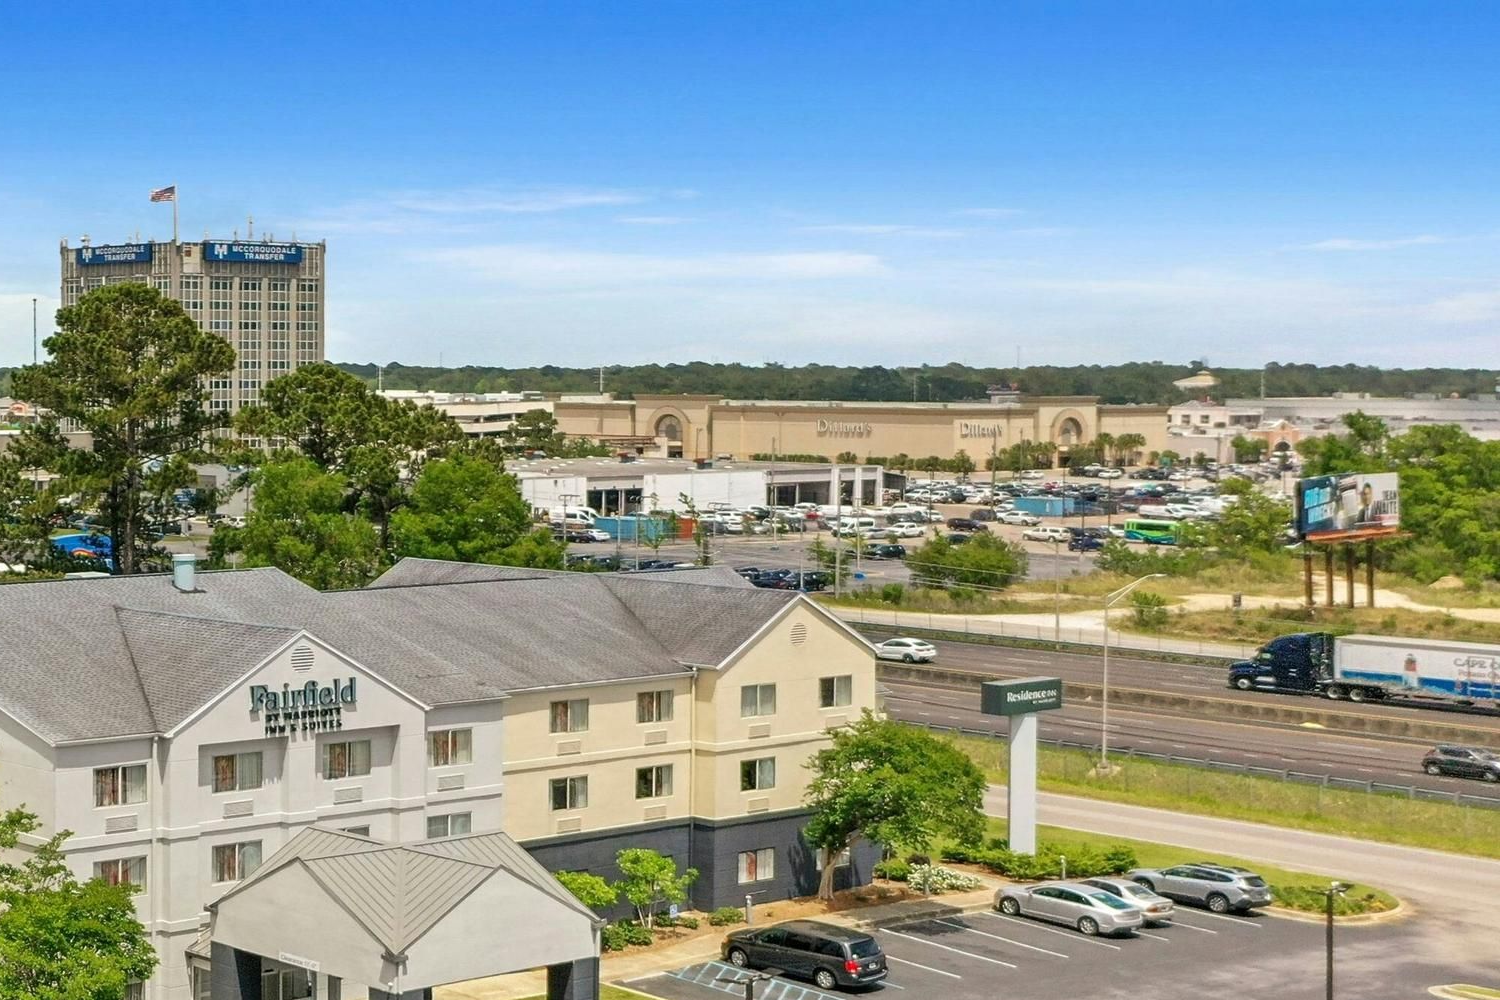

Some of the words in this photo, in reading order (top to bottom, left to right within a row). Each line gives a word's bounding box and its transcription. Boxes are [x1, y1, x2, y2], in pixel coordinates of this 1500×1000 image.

[232, 245, 297, 255] MCCORQUODALE
[243, 252, 285, 261] TRANSFER
[104, 253, 136, 262] TRANSFER
[248, 676, 358, 713] Fairfield
[1006, 689, 1047, 703] Residence
[265, 713, 280, 722] BY
[283, 707, 342, 720] MARRIOTT
[265, 725, 286, 735] INN
[301, 719, 342, 731] SUITES
